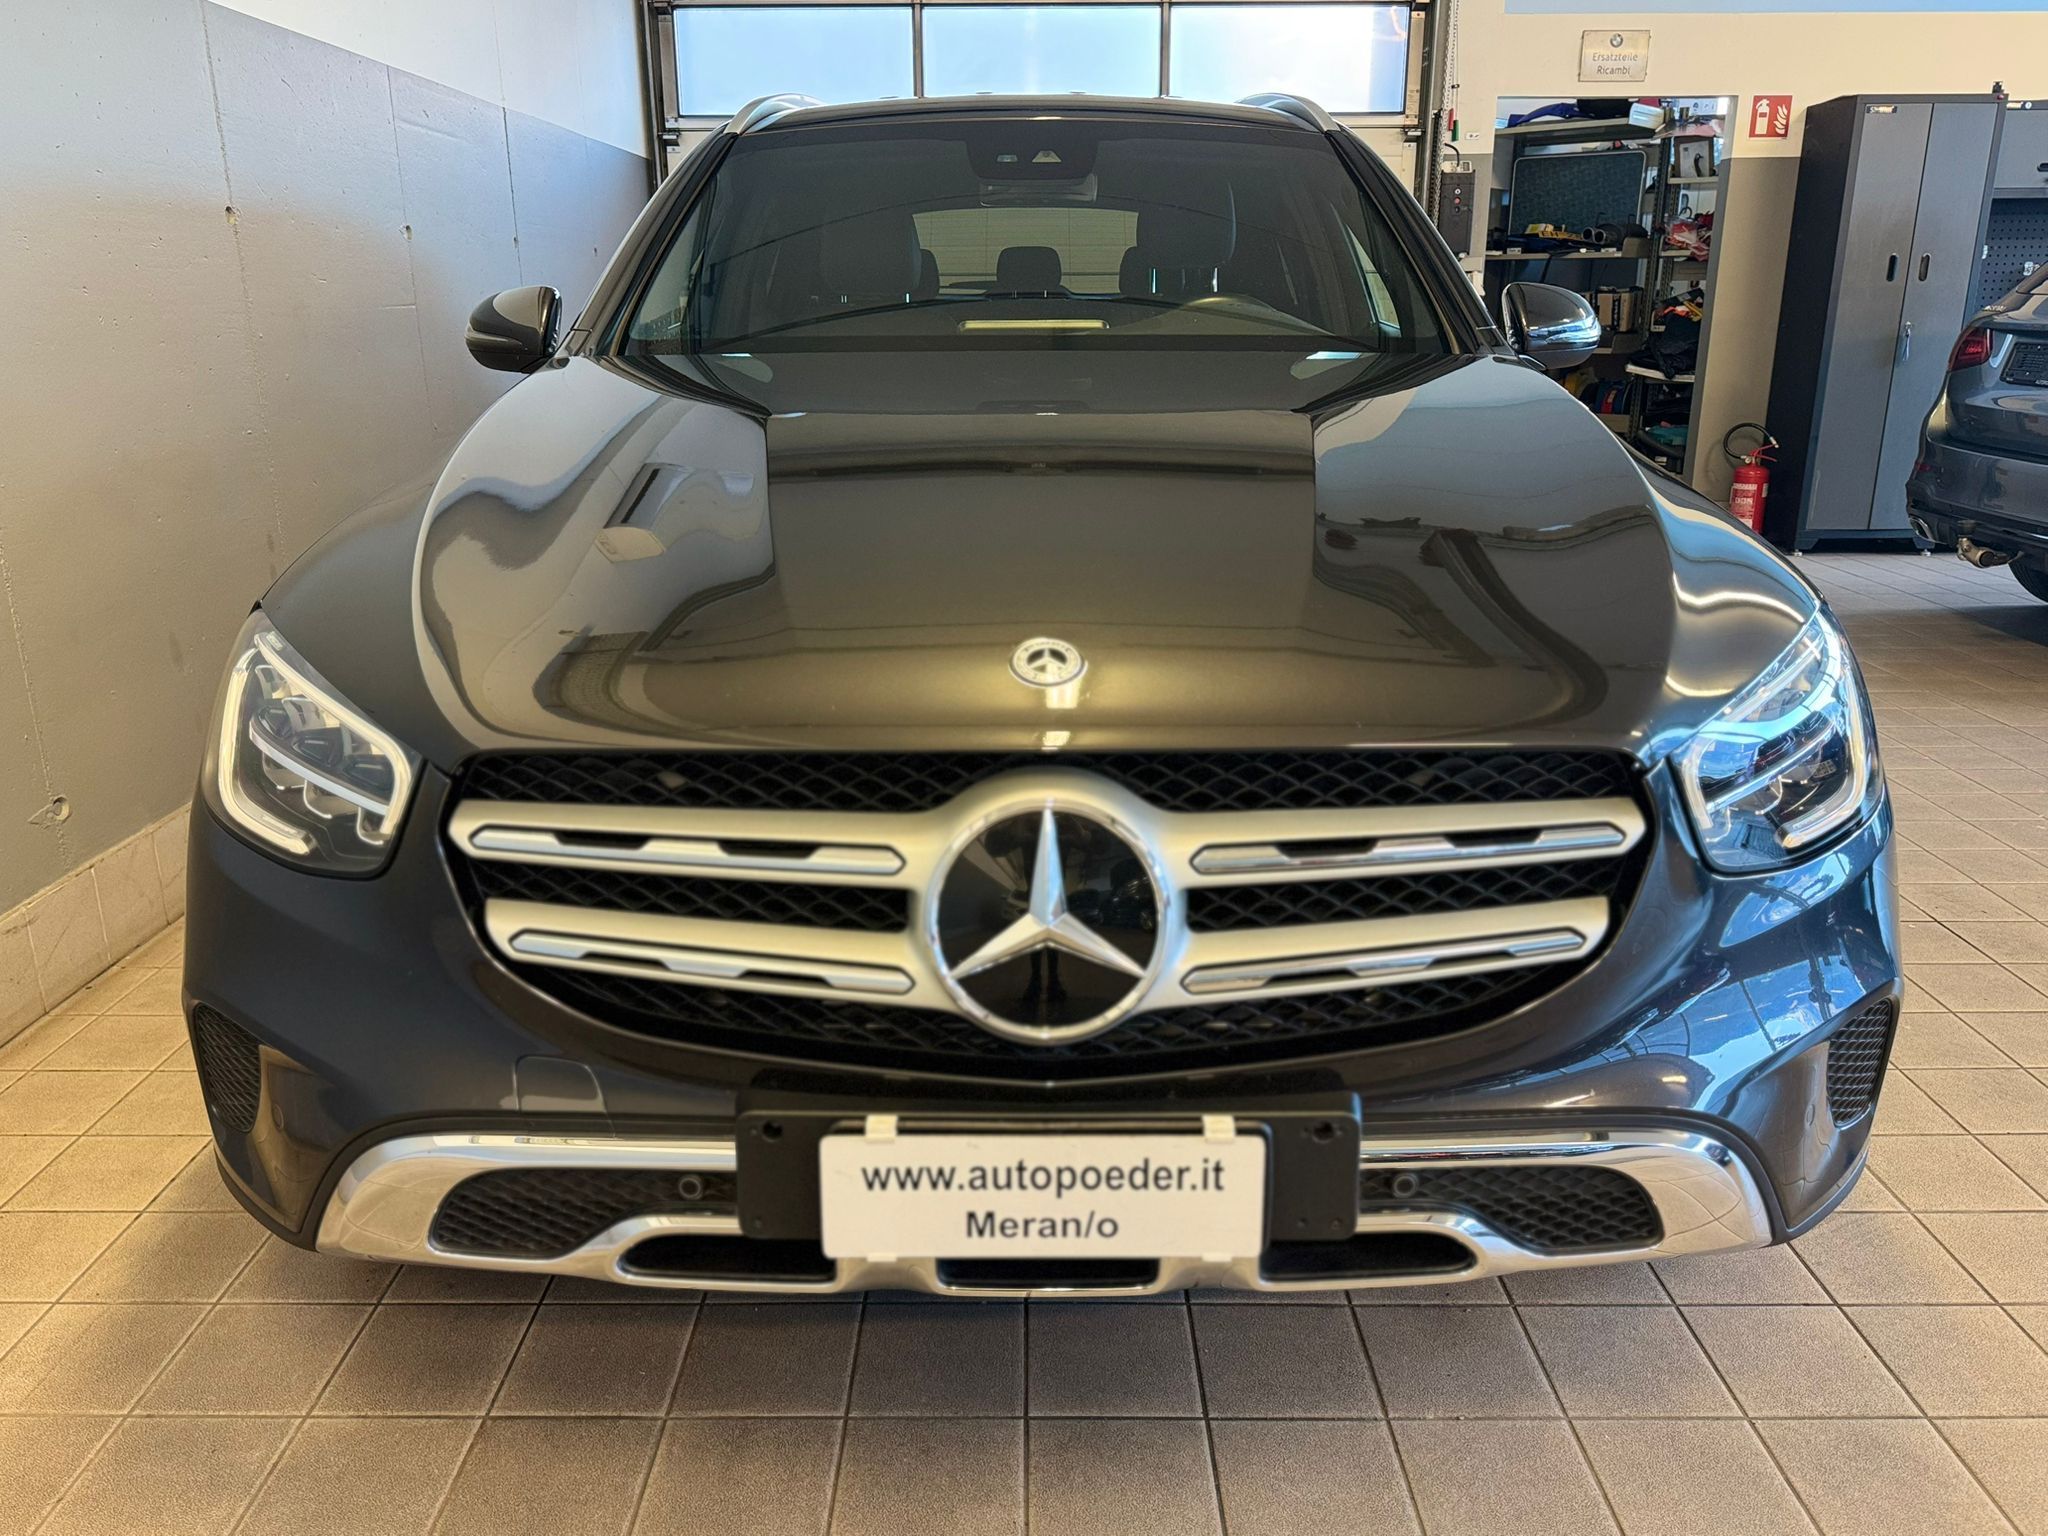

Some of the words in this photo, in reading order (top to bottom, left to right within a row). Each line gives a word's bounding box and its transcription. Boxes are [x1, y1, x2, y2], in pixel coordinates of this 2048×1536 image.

[1592, 52, 1638, 61] Ersatzteile
[1596, 65, 1631, 75] Ricambi
[861, 1157, 1225, 1198] www.autopoeder.it
[966, 1210, 1120, 1240] Meran/o
